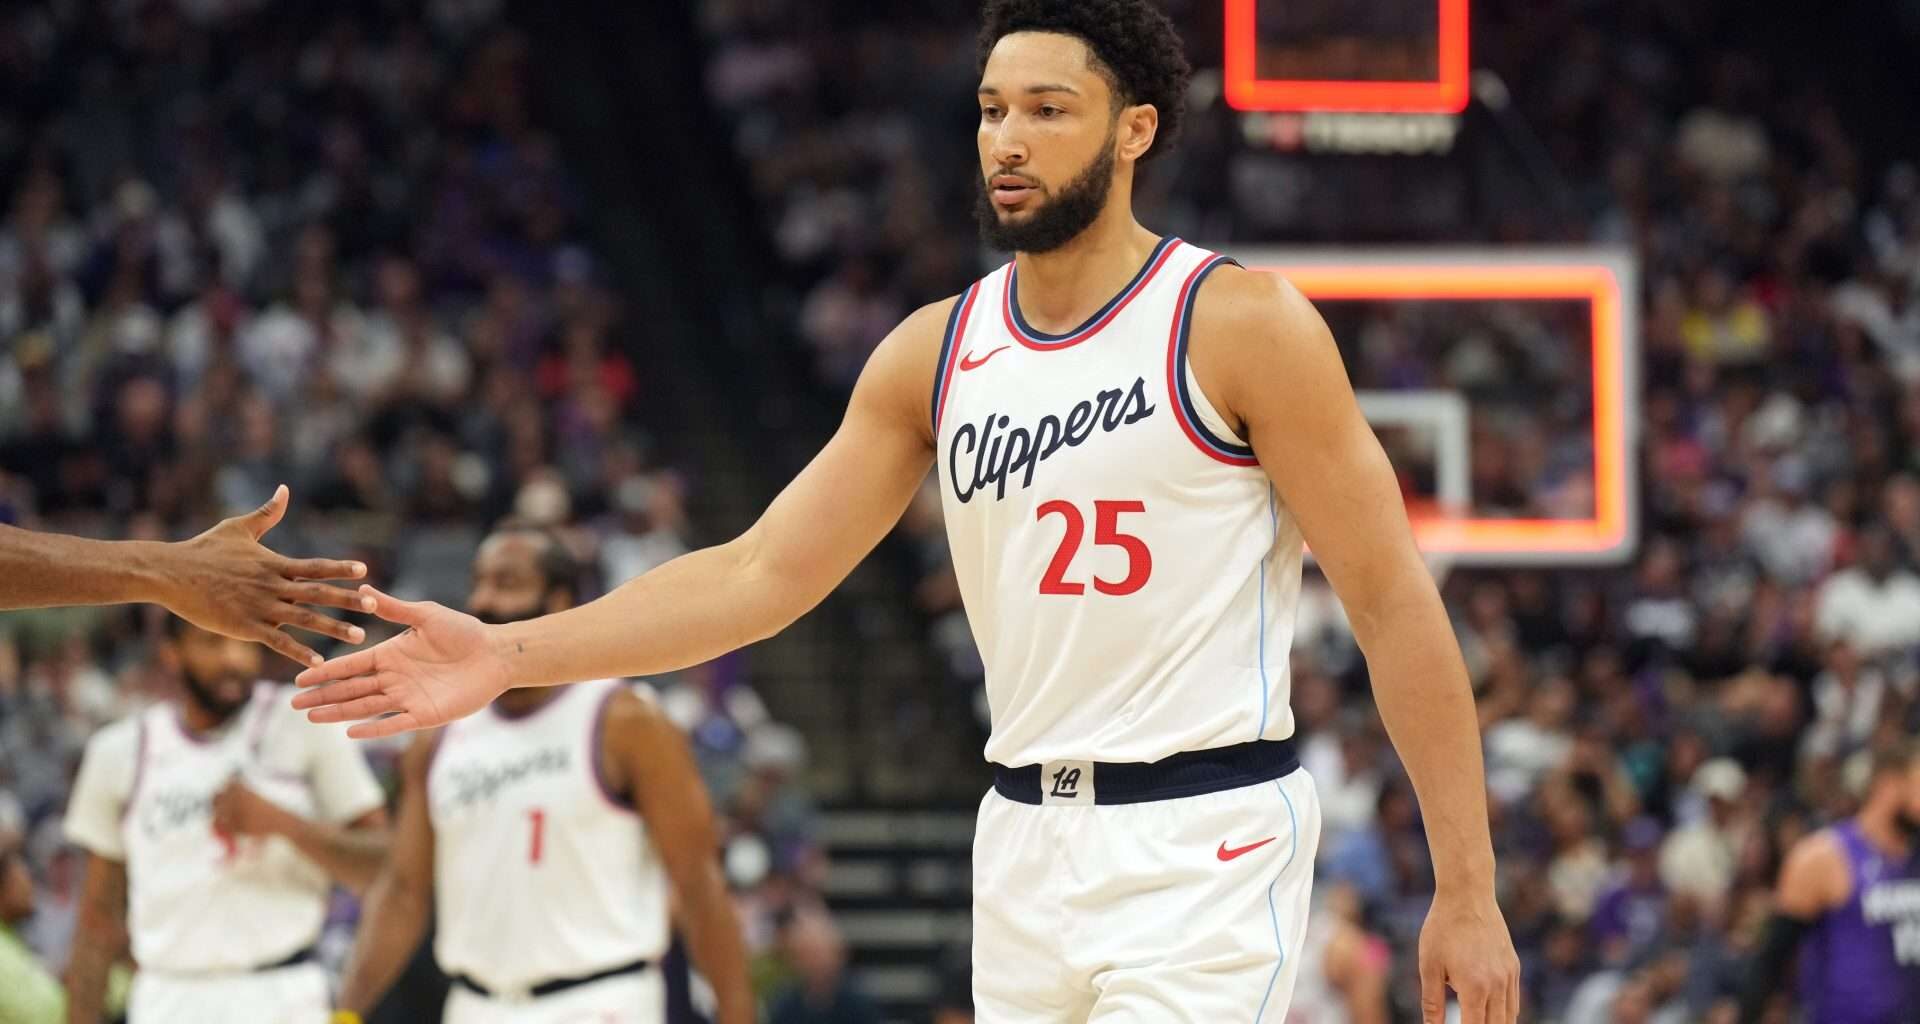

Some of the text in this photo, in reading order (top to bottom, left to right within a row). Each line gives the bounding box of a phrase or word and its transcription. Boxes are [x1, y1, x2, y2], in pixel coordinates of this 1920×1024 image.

[949, 376, 1156, 504] Clippers
[1036, 499, 1153, 596] 25
[1050, 765, 1081, 798] LA
[529, 807, 545, 866] 1
